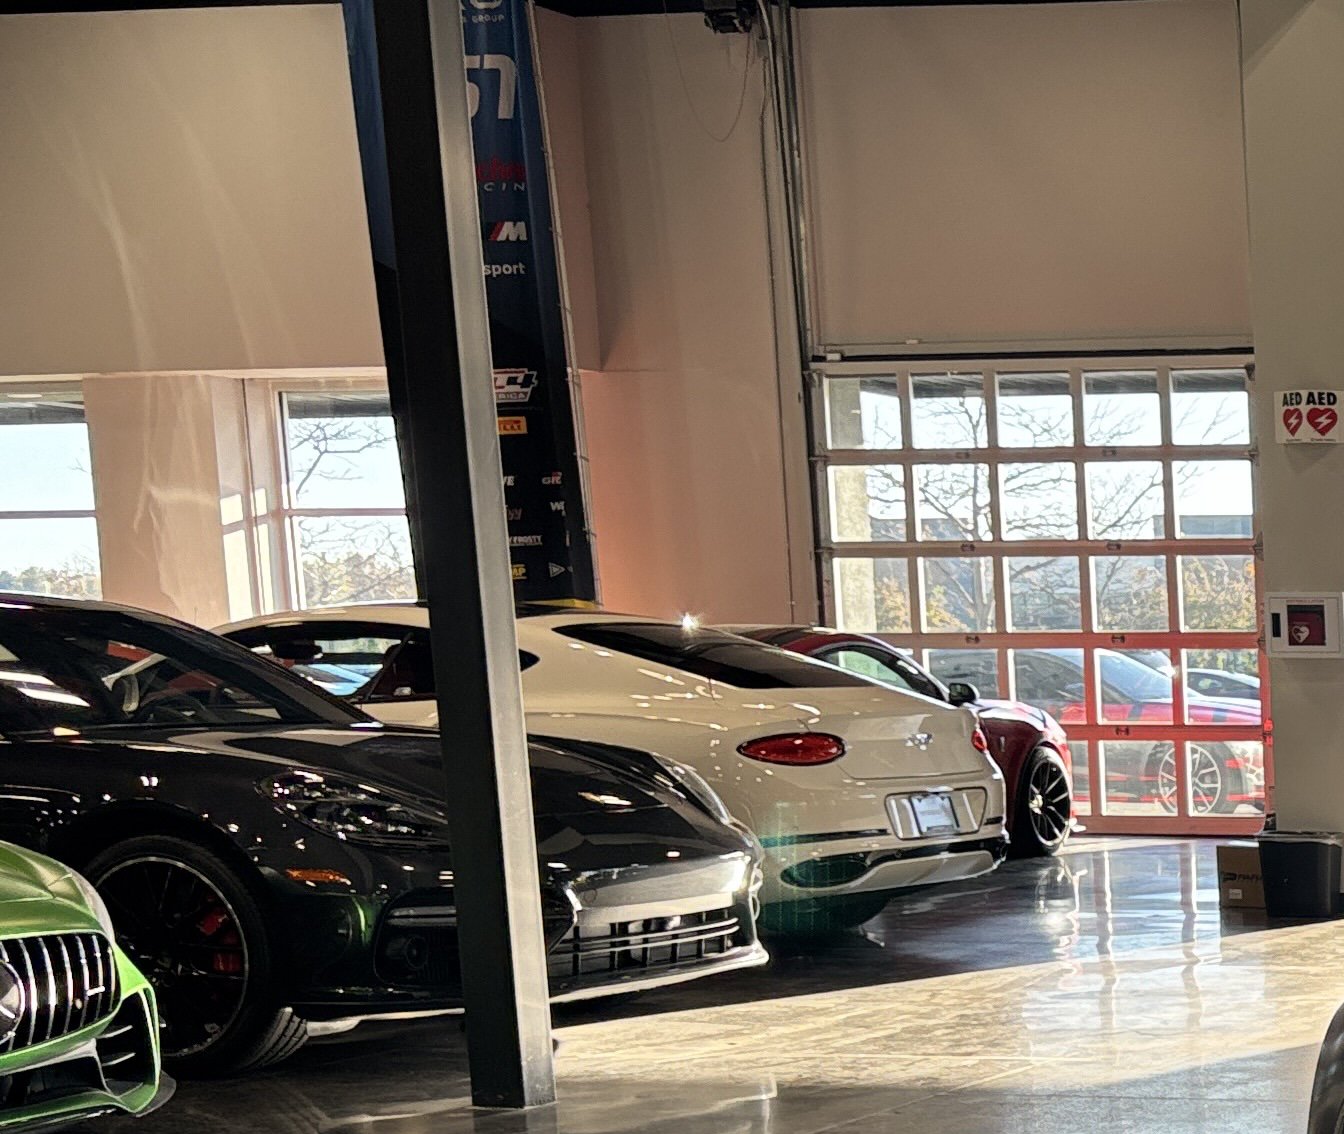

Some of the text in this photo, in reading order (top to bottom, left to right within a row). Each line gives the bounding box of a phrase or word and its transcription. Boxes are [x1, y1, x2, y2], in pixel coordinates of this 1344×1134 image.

[471, 14, 505, 23] GROUP
[483, 182, 526, 191] CIN
[483, 262, 526, 277] sport
[1282, 392, 1302, 407] AED
[1305, 392, 1337, 406] AED
